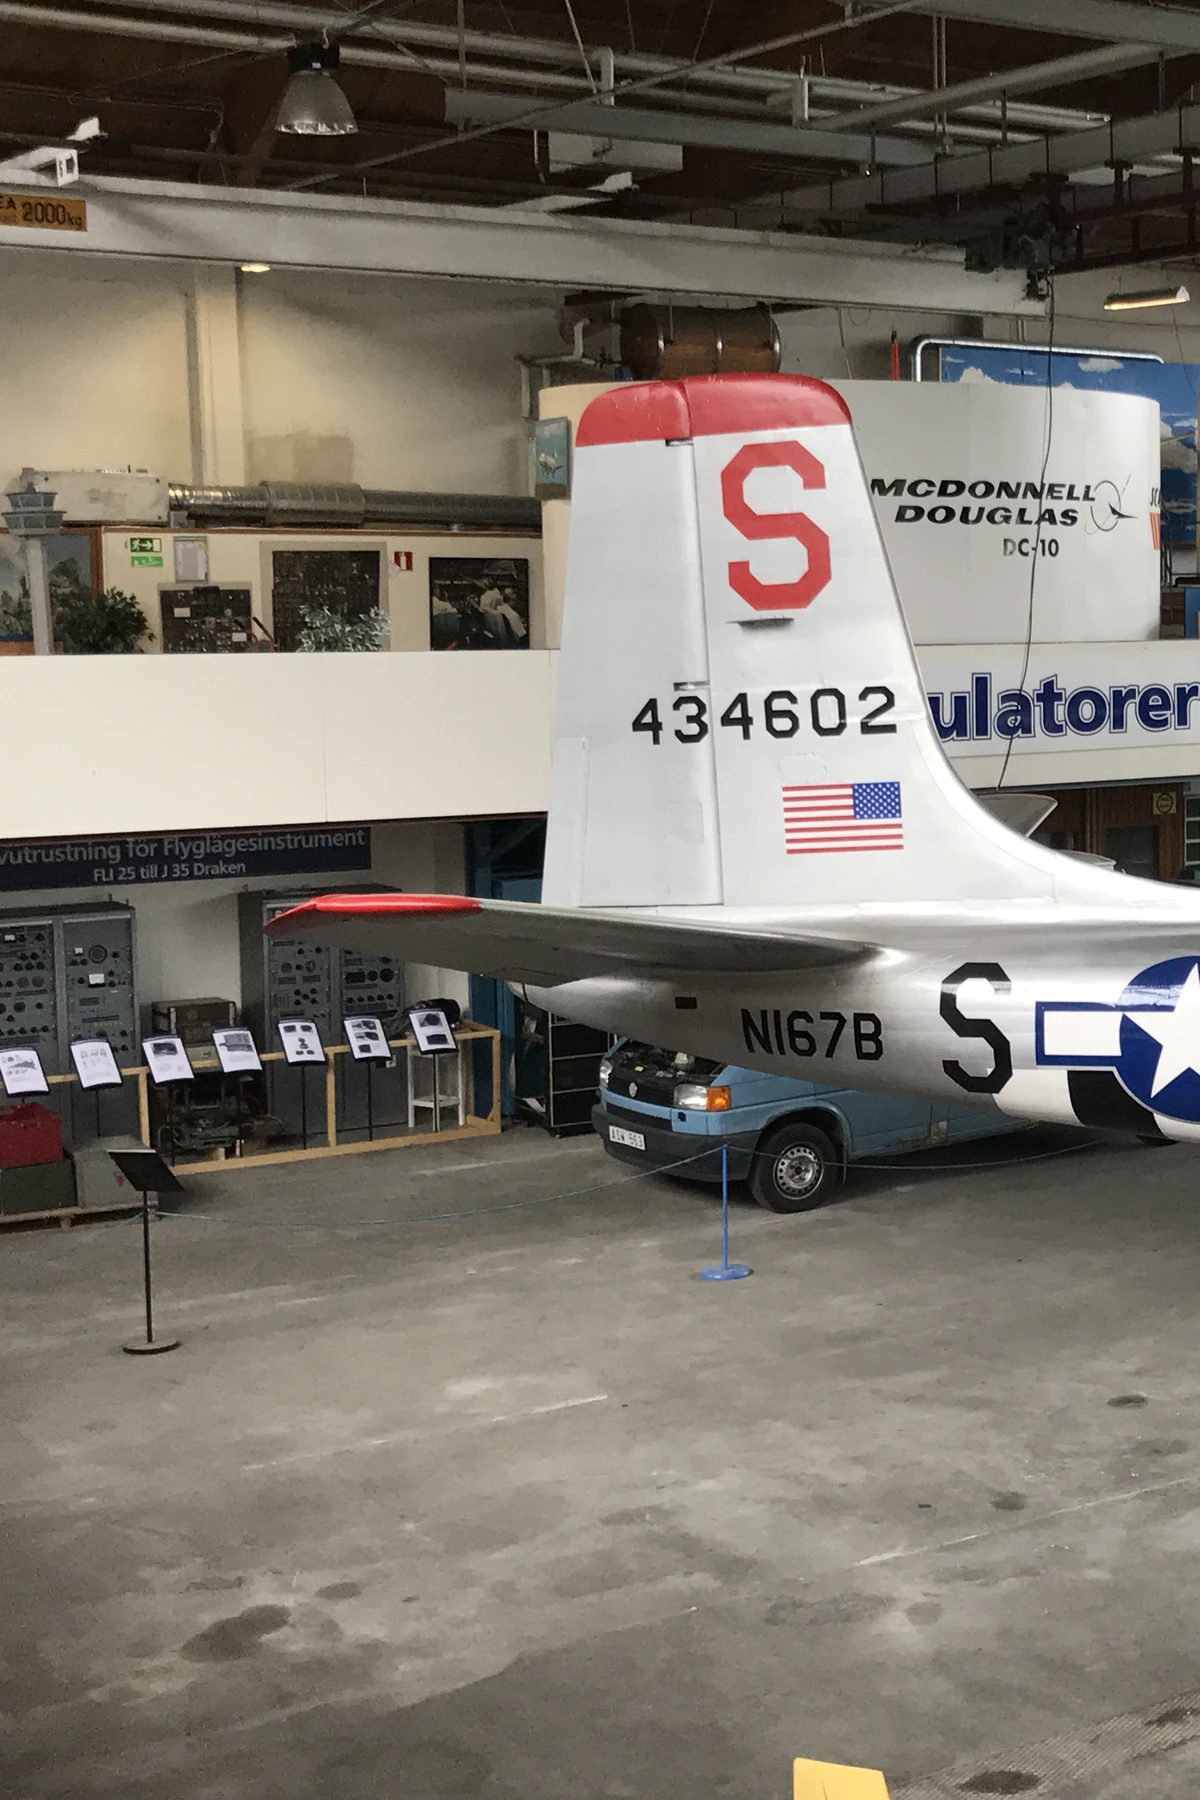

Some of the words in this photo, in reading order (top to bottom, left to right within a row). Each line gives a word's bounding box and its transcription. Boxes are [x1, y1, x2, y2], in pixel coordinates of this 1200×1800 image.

[870, 478, 1096, 502] MCDONNELL
[720, 439, 833, 611] S
[894, 505, 1080, 527] DOUGLAS
[1002, 537, 1060, 558] DC-10
[631, 685, 898, 746] 434602
[126, 838, 157, 858] för
[164, 829, 366, 860] Flyglägesinstrument
[118, 867, 136, 881] 25
[140, 865, 158, 880] till
[161, 865, 168, 879] J
[172, 863, 190, 877] 35
[193, 860, 246, 876] Draken
[939, 962, 1013, 1094] S
